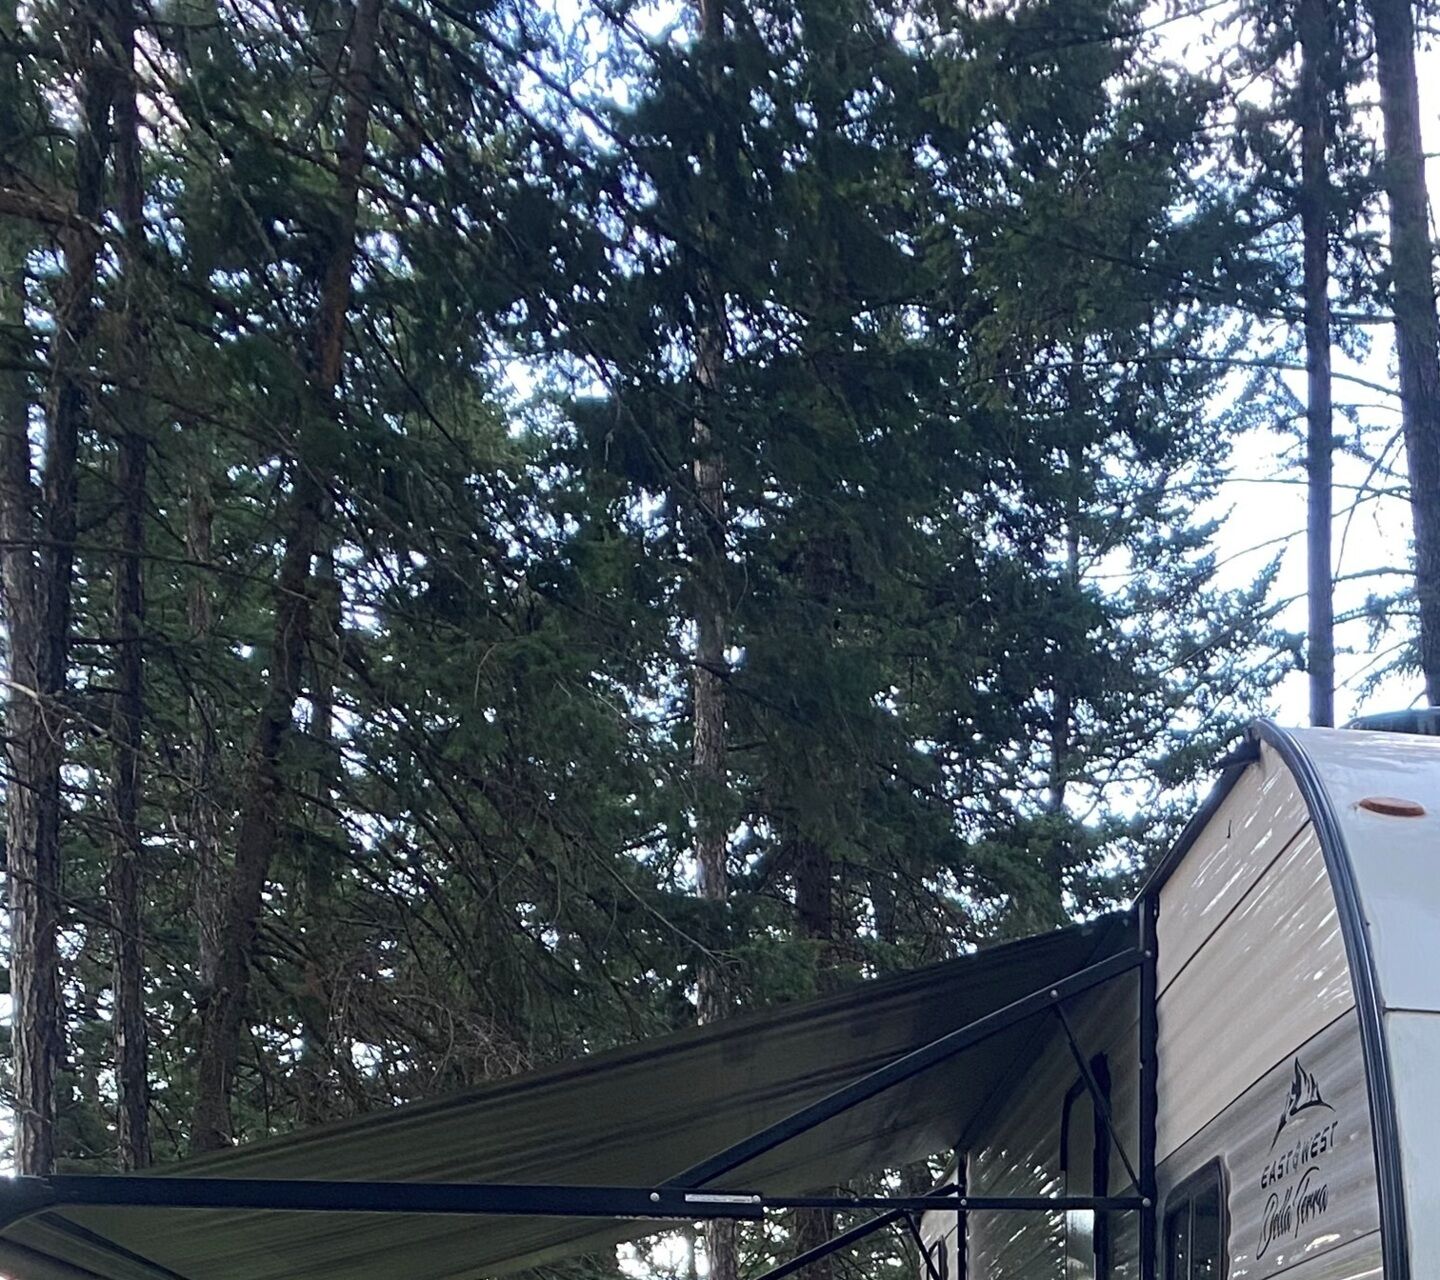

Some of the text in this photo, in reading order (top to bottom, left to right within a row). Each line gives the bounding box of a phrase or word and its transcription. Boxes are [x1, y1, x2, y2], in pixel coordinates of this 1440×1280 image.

[1261, 1150, 1293, 1189] EAST
[1301, 1121, 1338, 1164] WEST
[1256, 1166, 1329, 1260] Della Terra
